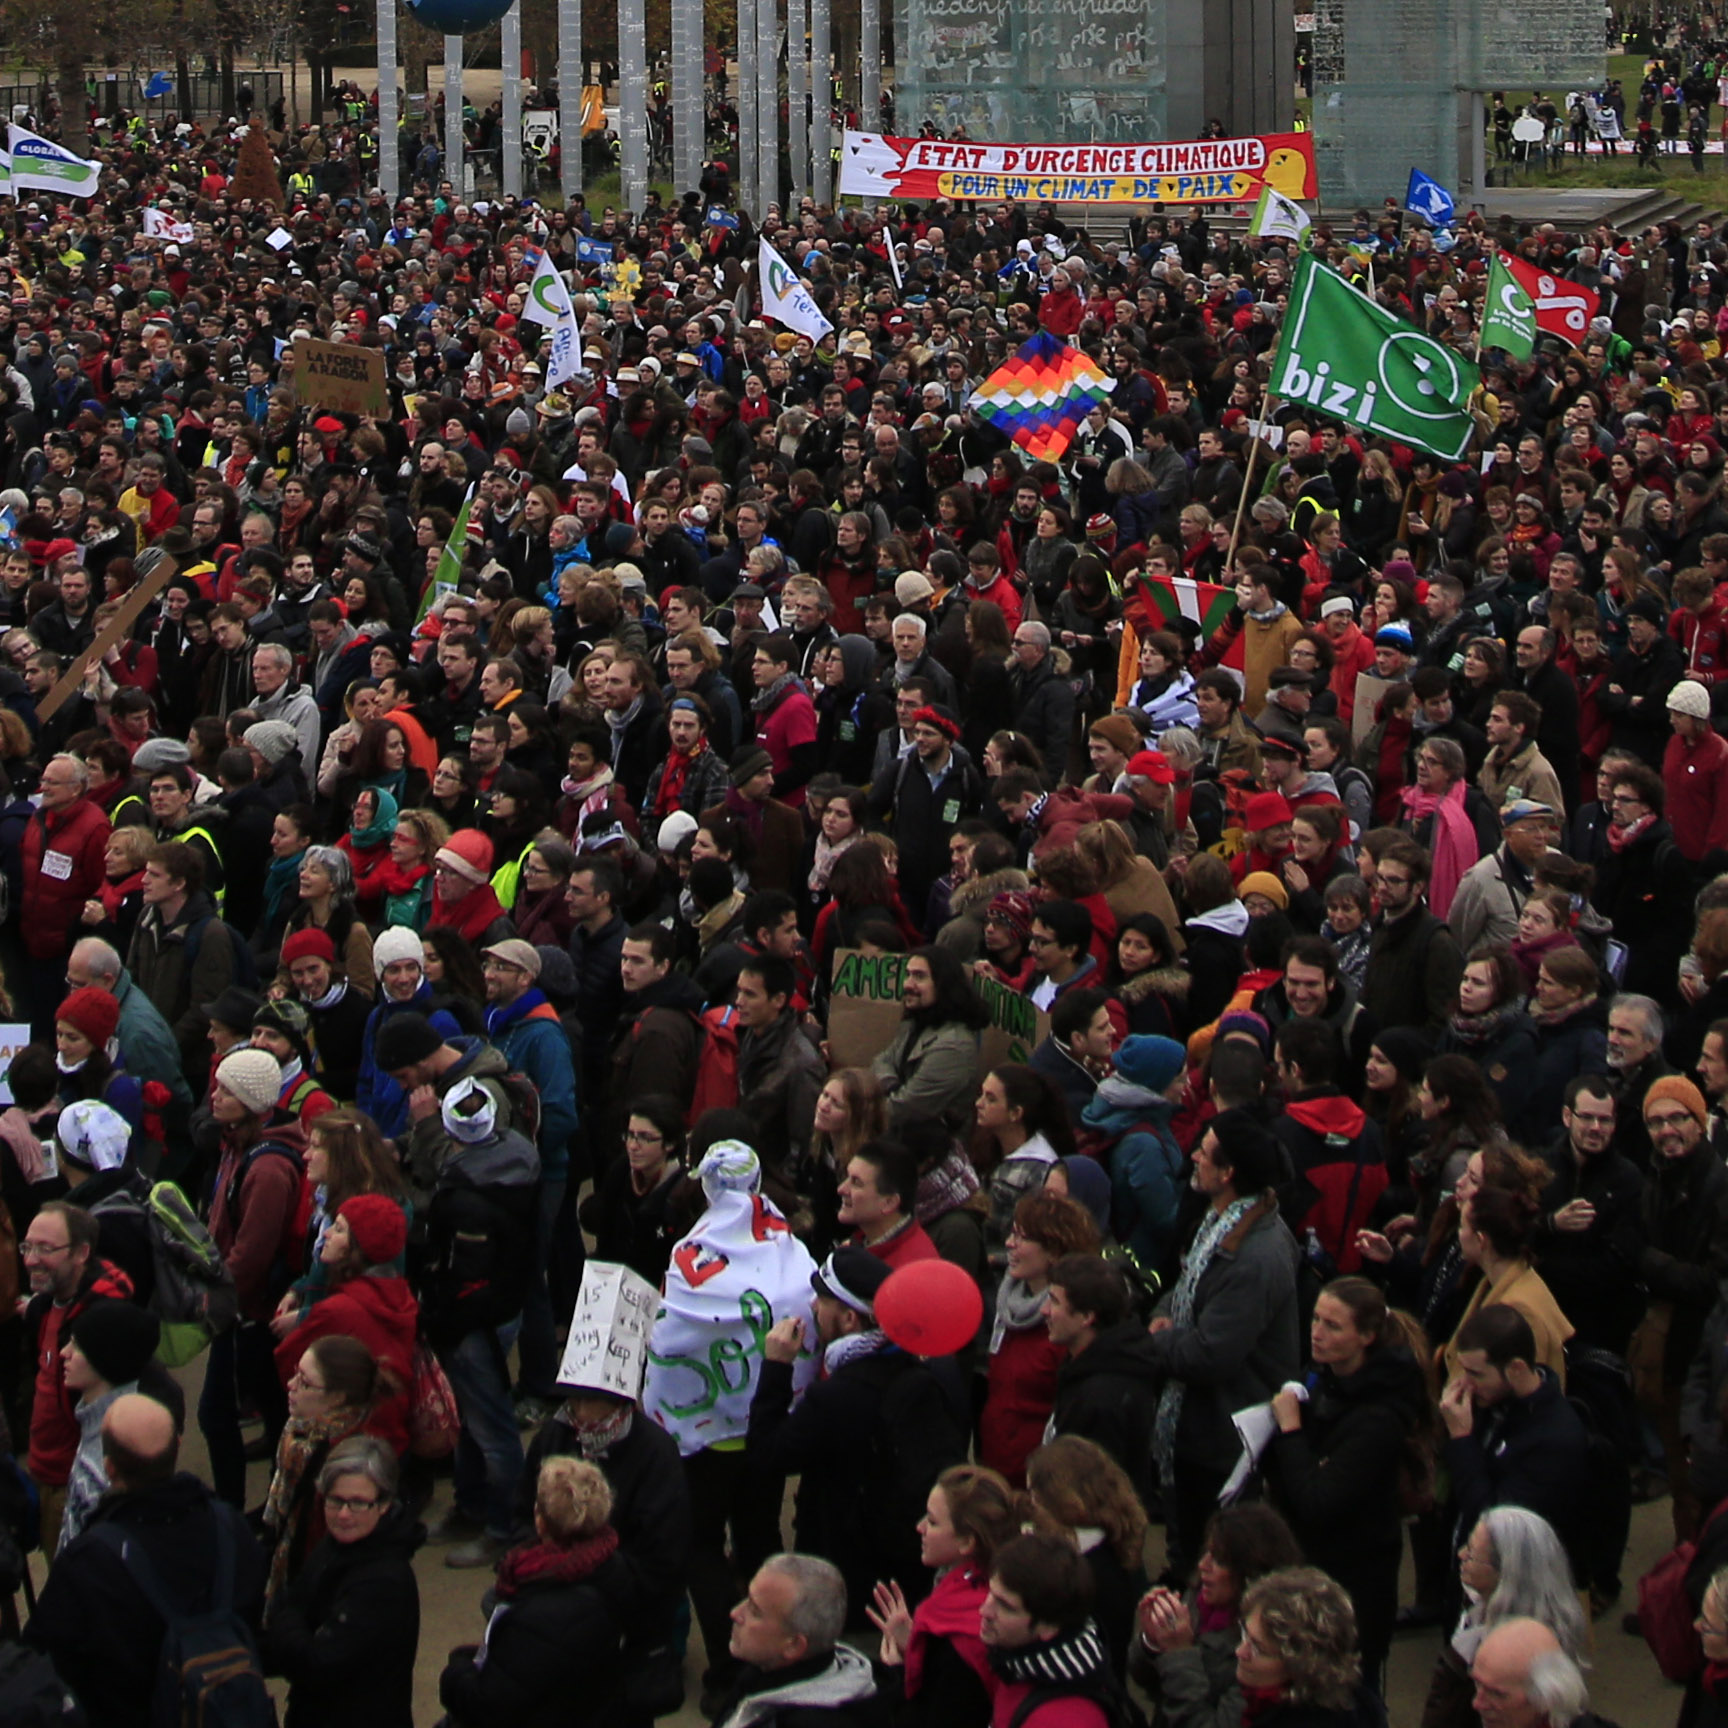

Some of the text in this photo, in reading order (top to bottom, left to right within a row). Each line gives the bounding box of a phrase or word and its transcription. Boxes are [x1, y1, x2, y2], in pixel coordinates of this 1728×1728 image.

[918, 141, 1261, 173] ETAT D'URGENCE CLIMATIQUE
[951, 173, 1235, 201] POUR UN CLIMAT DE PAIX
[306, 350, 323, 363] LA
[1278, 352, 1376, 425] bizi
